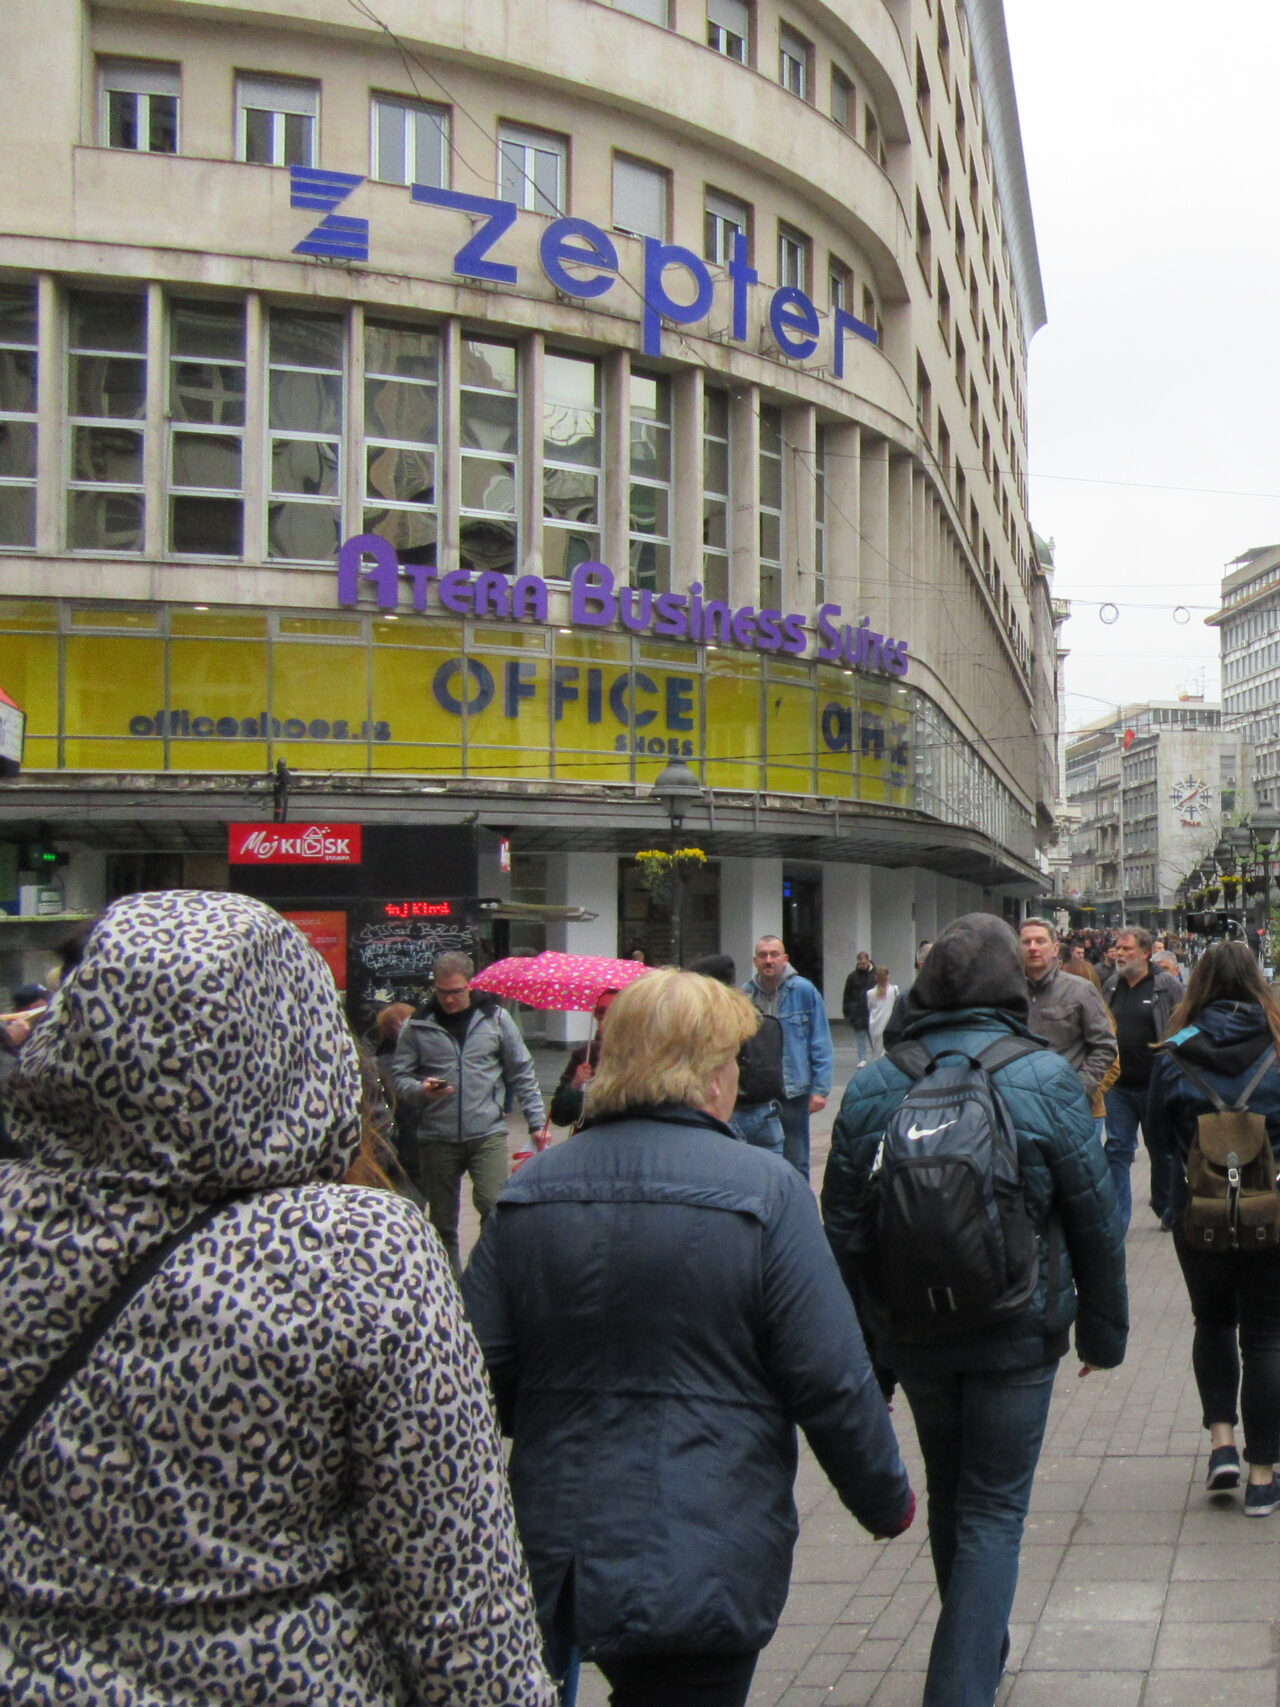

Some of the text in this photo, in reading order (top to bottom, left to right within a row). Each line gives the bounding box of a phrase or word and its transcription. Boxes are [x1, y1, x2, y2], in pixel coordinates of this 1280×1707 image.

[432, 657, 695, 731] OFFICE
[615, 733, 694, 757] SHOES
[240, 831, 279, 858] Moj
